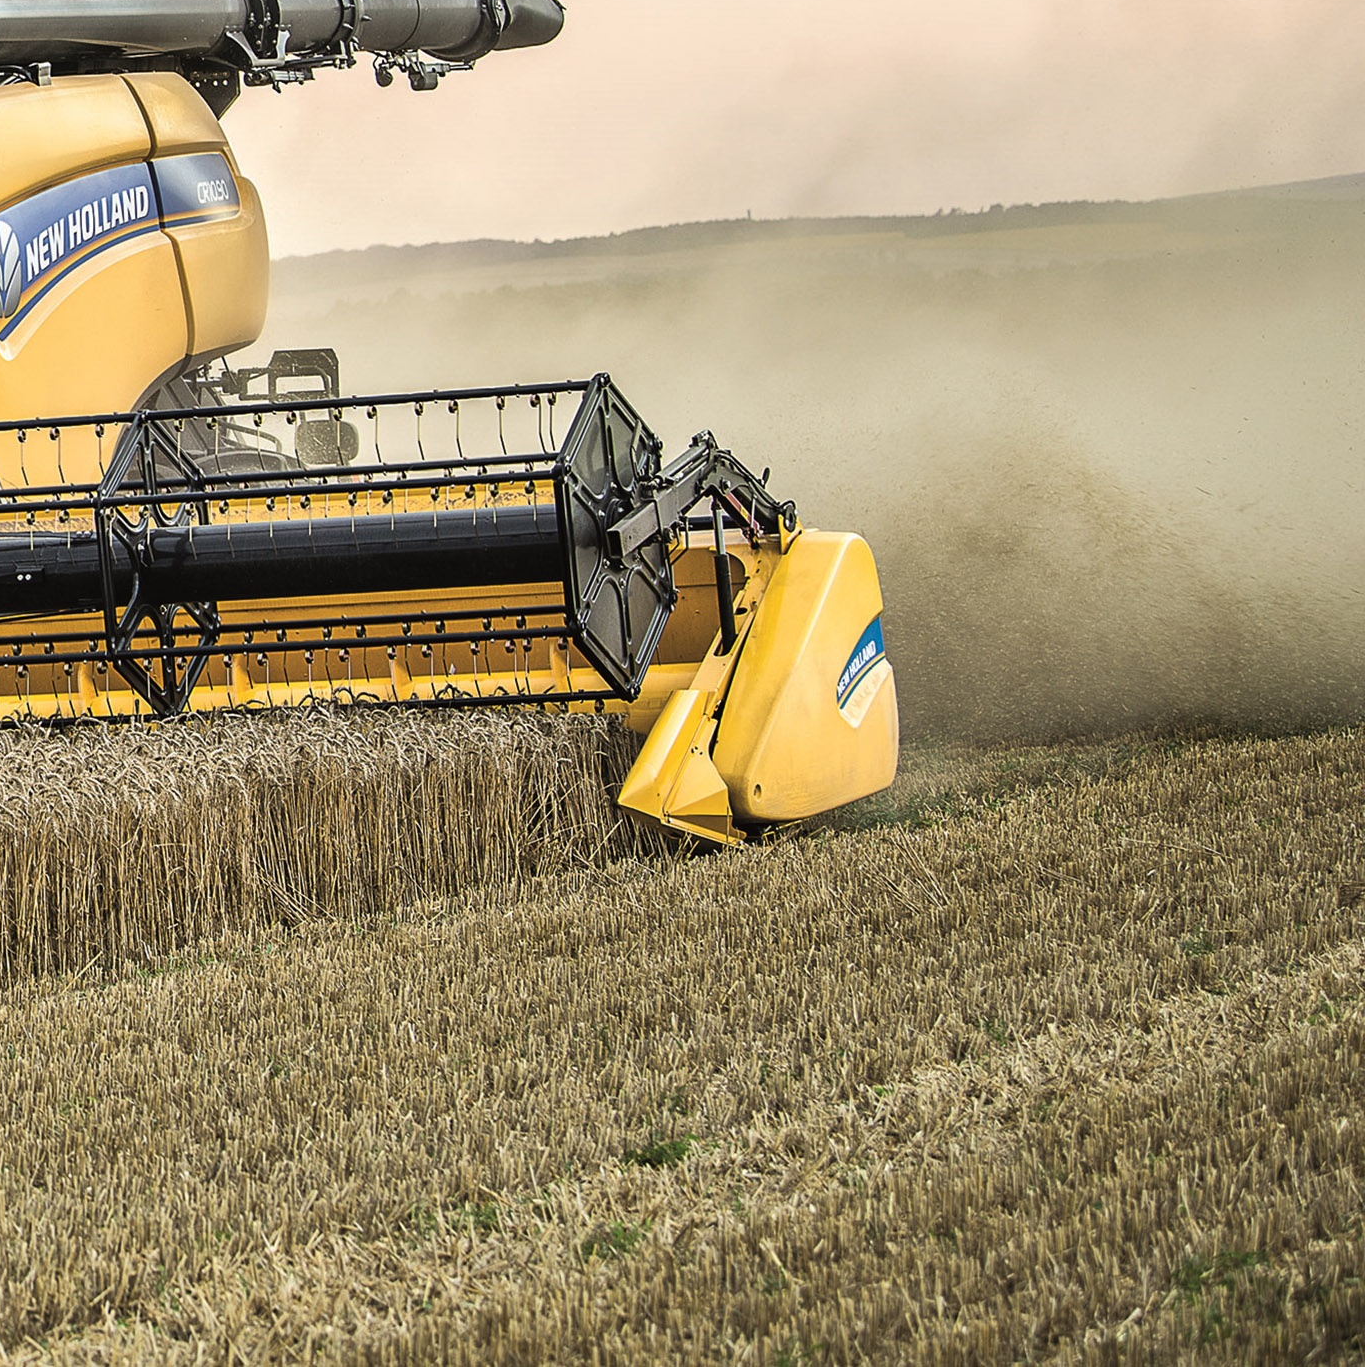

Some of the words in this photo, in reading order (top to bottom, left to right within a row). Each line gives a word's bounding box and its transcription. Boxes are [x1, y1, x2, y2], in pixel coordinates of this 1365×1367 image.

[25, 218, 66, 283] NEW
[68, 185, 149, 250] HOLLAND
[837, 668, 850, 698] NEW
[849, 640, 877, 679] HOLLAND
